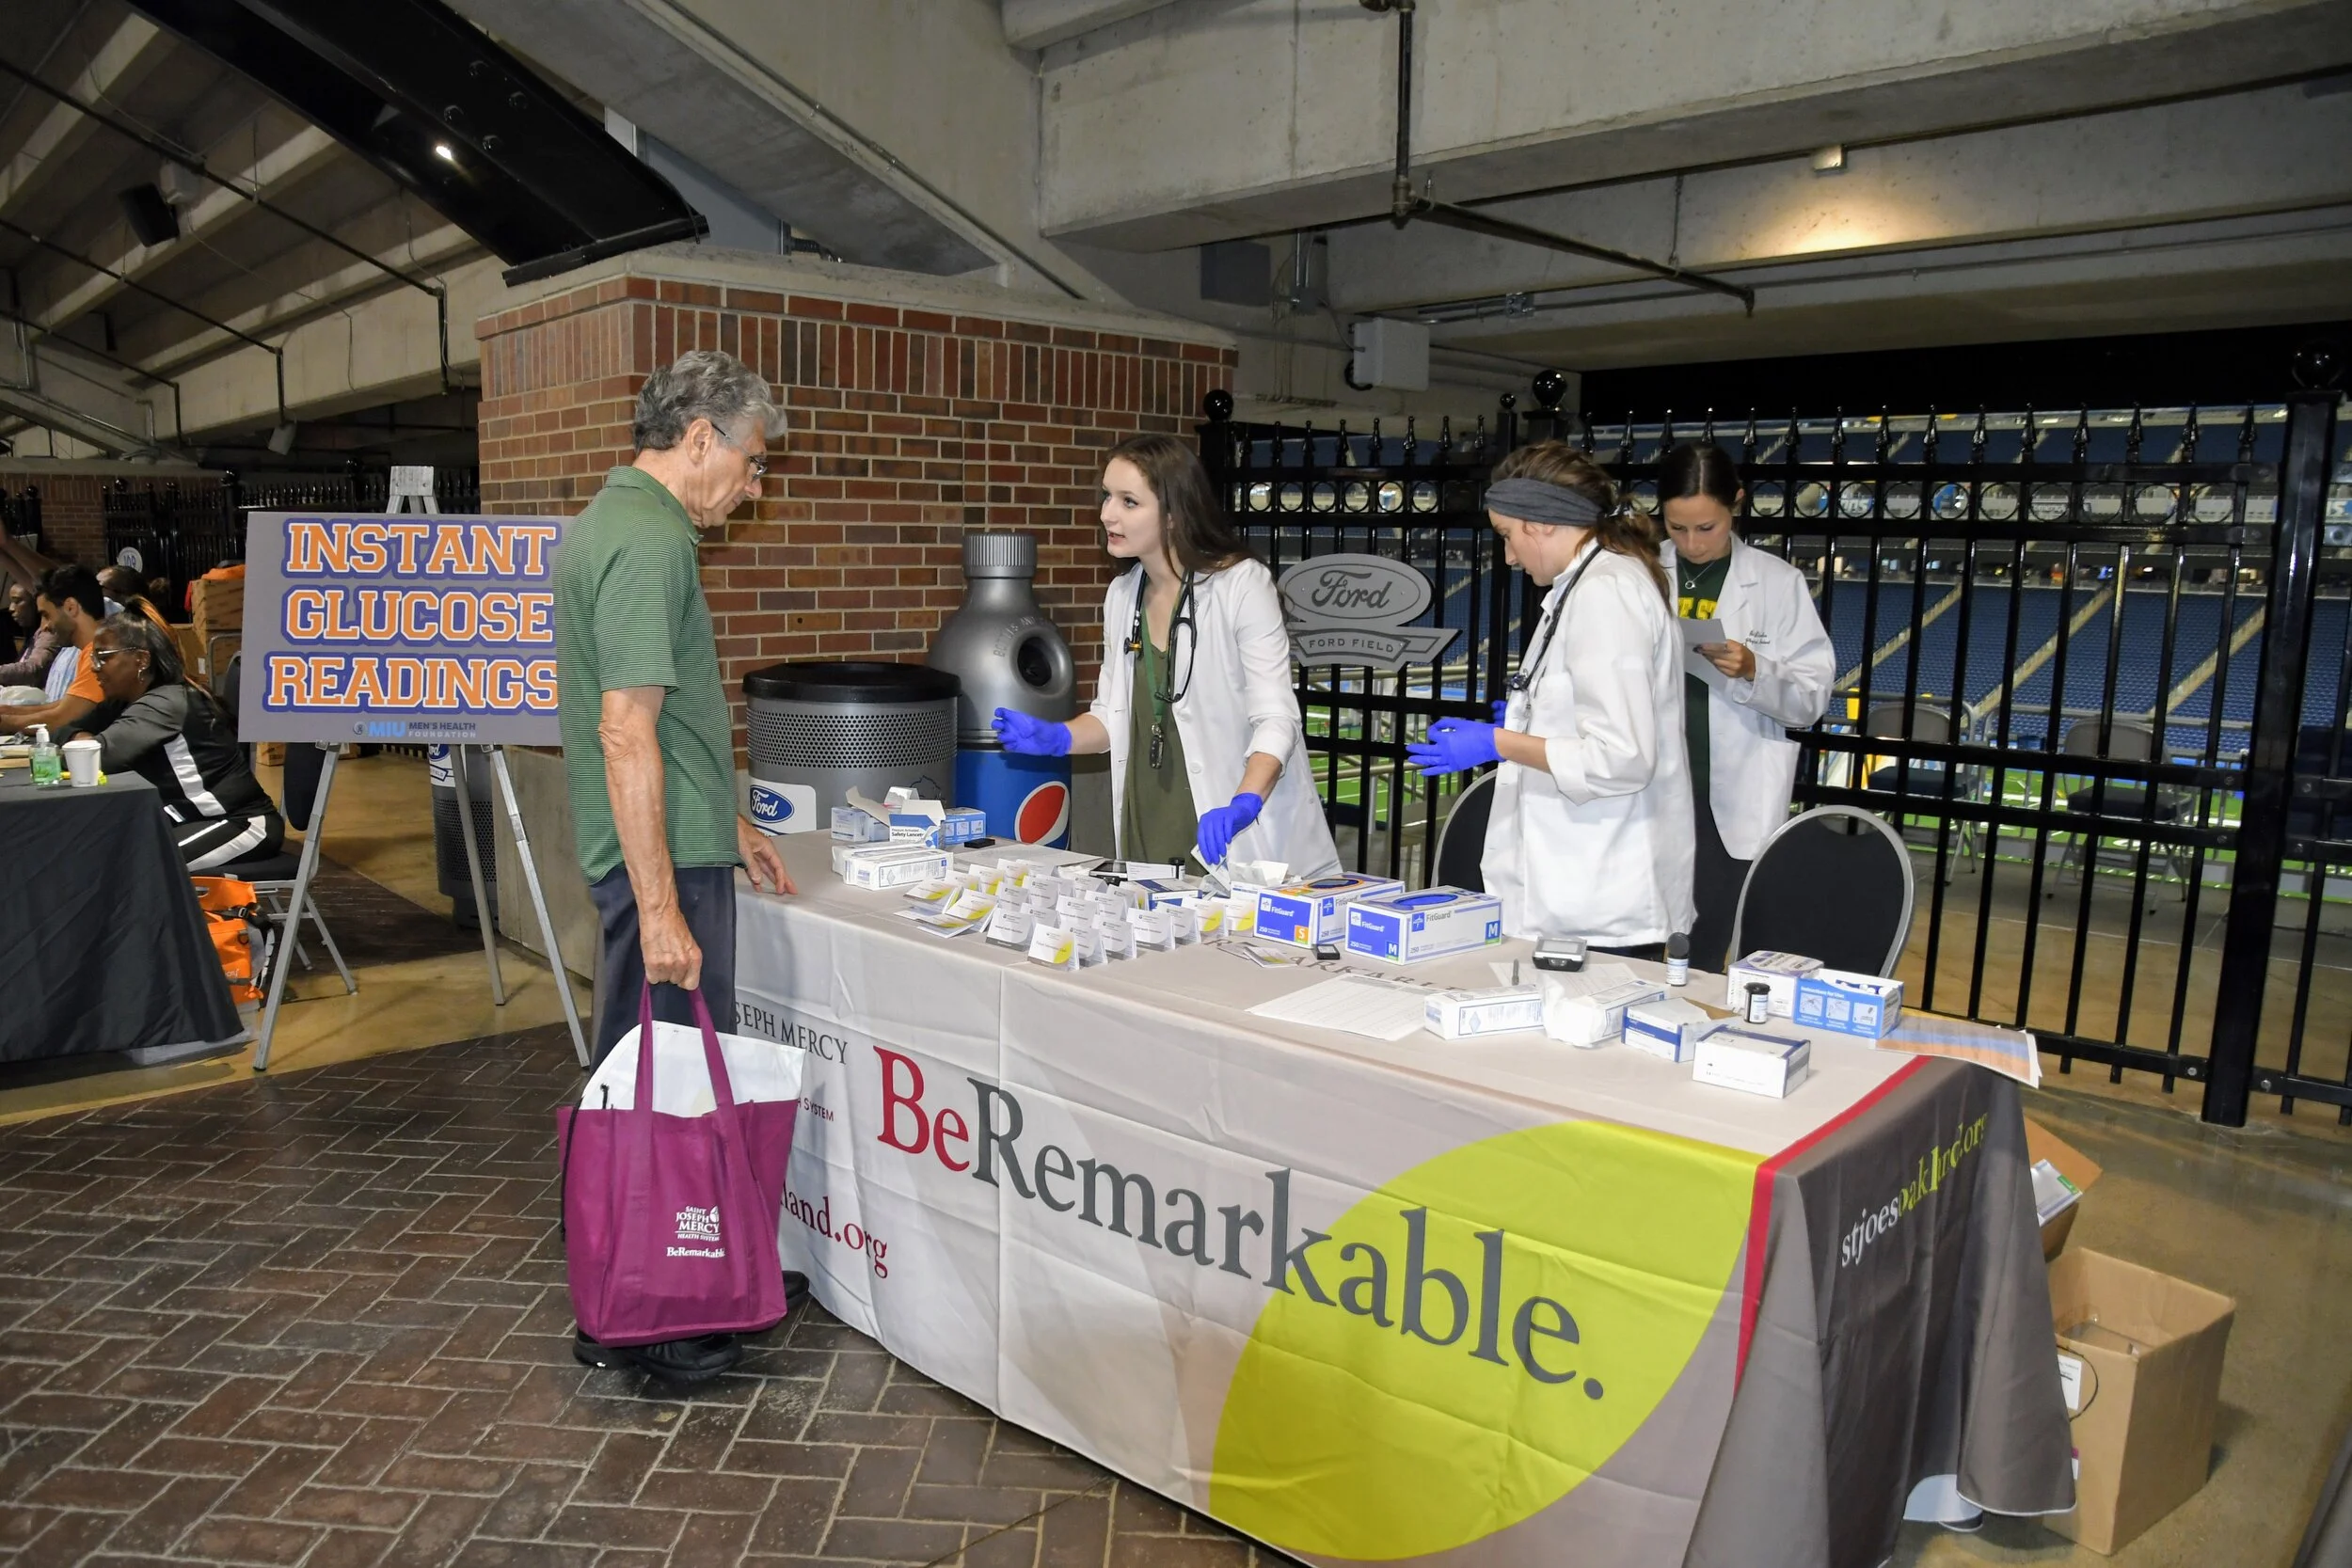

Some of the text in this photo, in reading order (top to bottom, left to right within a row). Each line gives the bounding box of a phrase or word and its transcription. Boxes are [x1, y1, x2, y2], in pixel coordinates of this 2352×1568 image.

[285, 522, 557, 576] INSTANT
[1311, 569, 1392, 609] Ford
[286, 589, 554, 642] GLUCOSE
[1309, 639, 1393, 653] FORD FIELD
[267, 656, 559, 710] READINGS
[368, 721, 476, 737] MIU MEN'S HEALTH
[408, 730, 476, 738] FOUNDATION
[752, 789, 779, 817] Ford
[1271, 906, 1295, 917] FitGuard
[1426, 911, 1452, 922] FitGuard
[1297, 927, 1306, 940] S
[1361, 921, 1385, 932] FitGuard
[1487, 922, 1499, 937] M
[1388, 942, 1398, 956] M
[734, 1002, 848, 1065] SEPH MERCY
[803, 1097, 834, 1122] SYSTEM
[685, 1205, 707, 1215] SAINT
[675, 1212, 710, 1224] JOSEPH
[872, 1044, 1604, 1400] BeRemarkable.
[678, 1220, 720, 1233] MERCY
[783, 1178, 888, 1279] land.org
